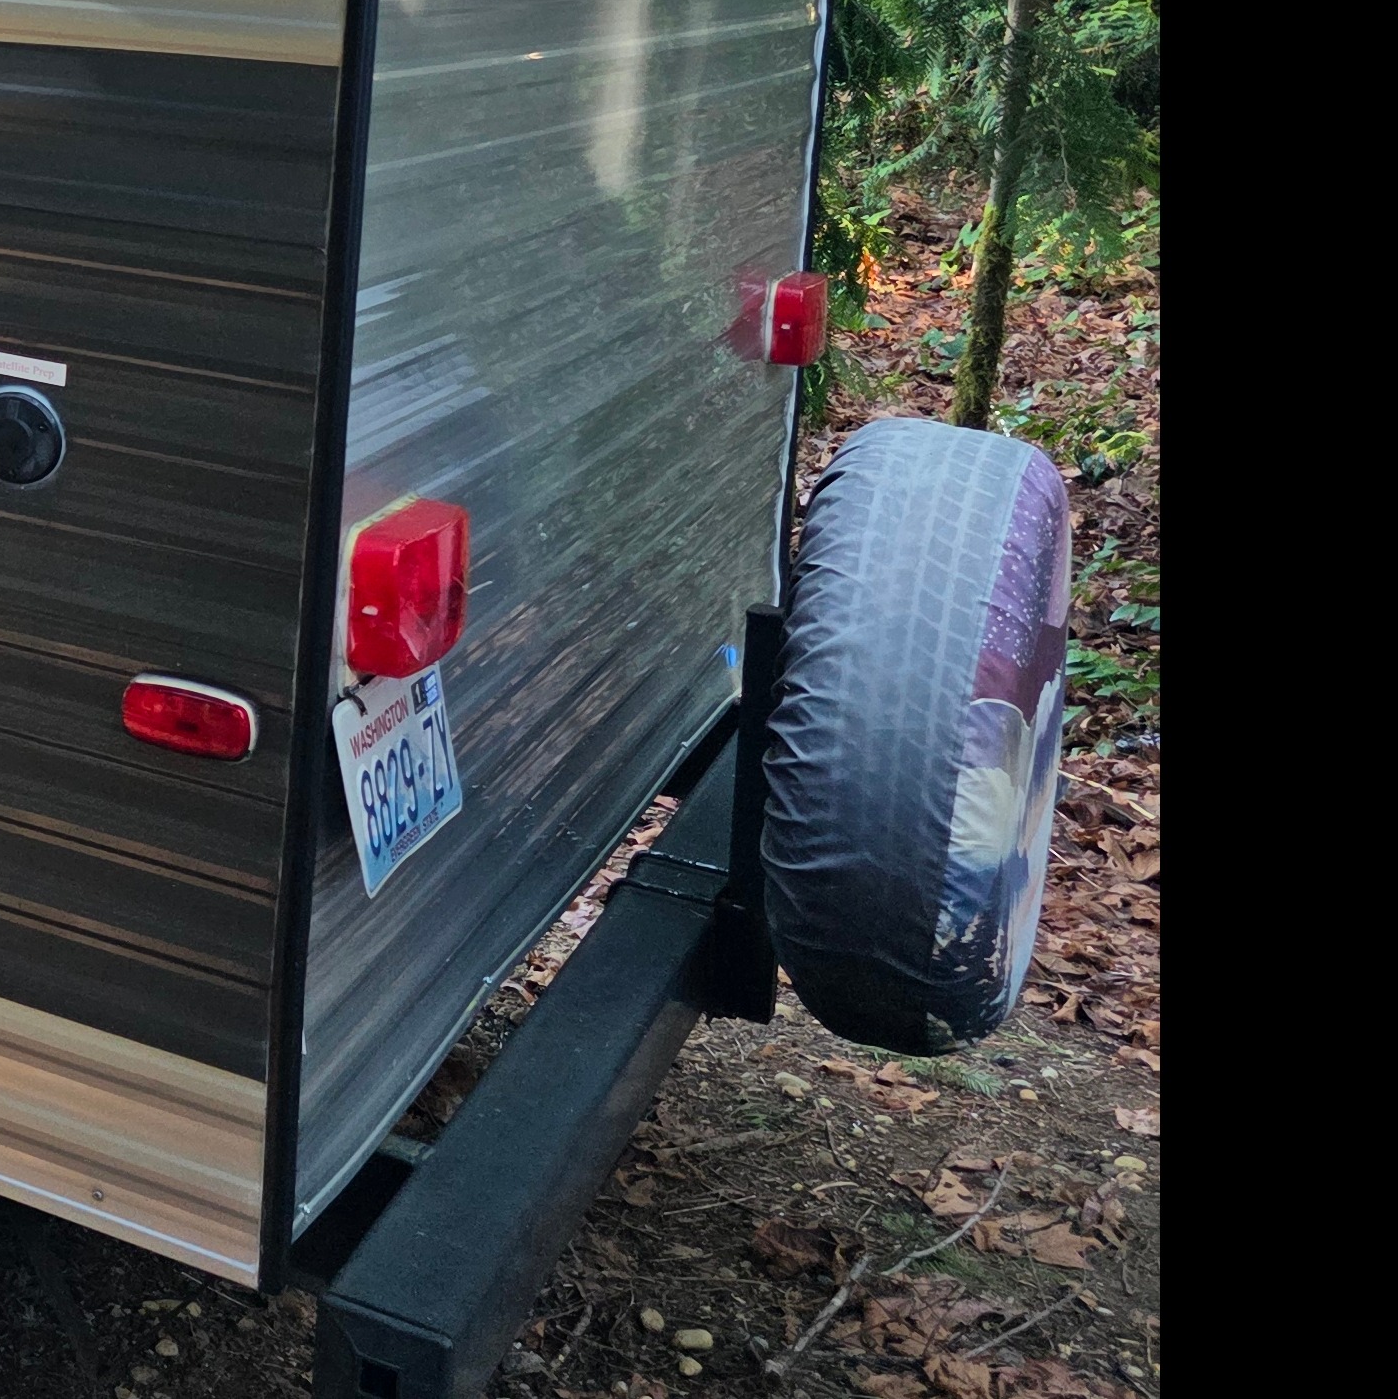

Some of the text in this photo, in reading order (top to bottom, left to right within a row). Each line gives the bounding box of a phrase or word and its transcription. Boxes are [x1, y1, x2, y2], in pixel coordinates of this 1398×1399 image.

[33, 365, 55, 380] Prep
[349, 694, 409, 760] WASHINGTON
[360, 704, 454, 859] 8829-ZY
